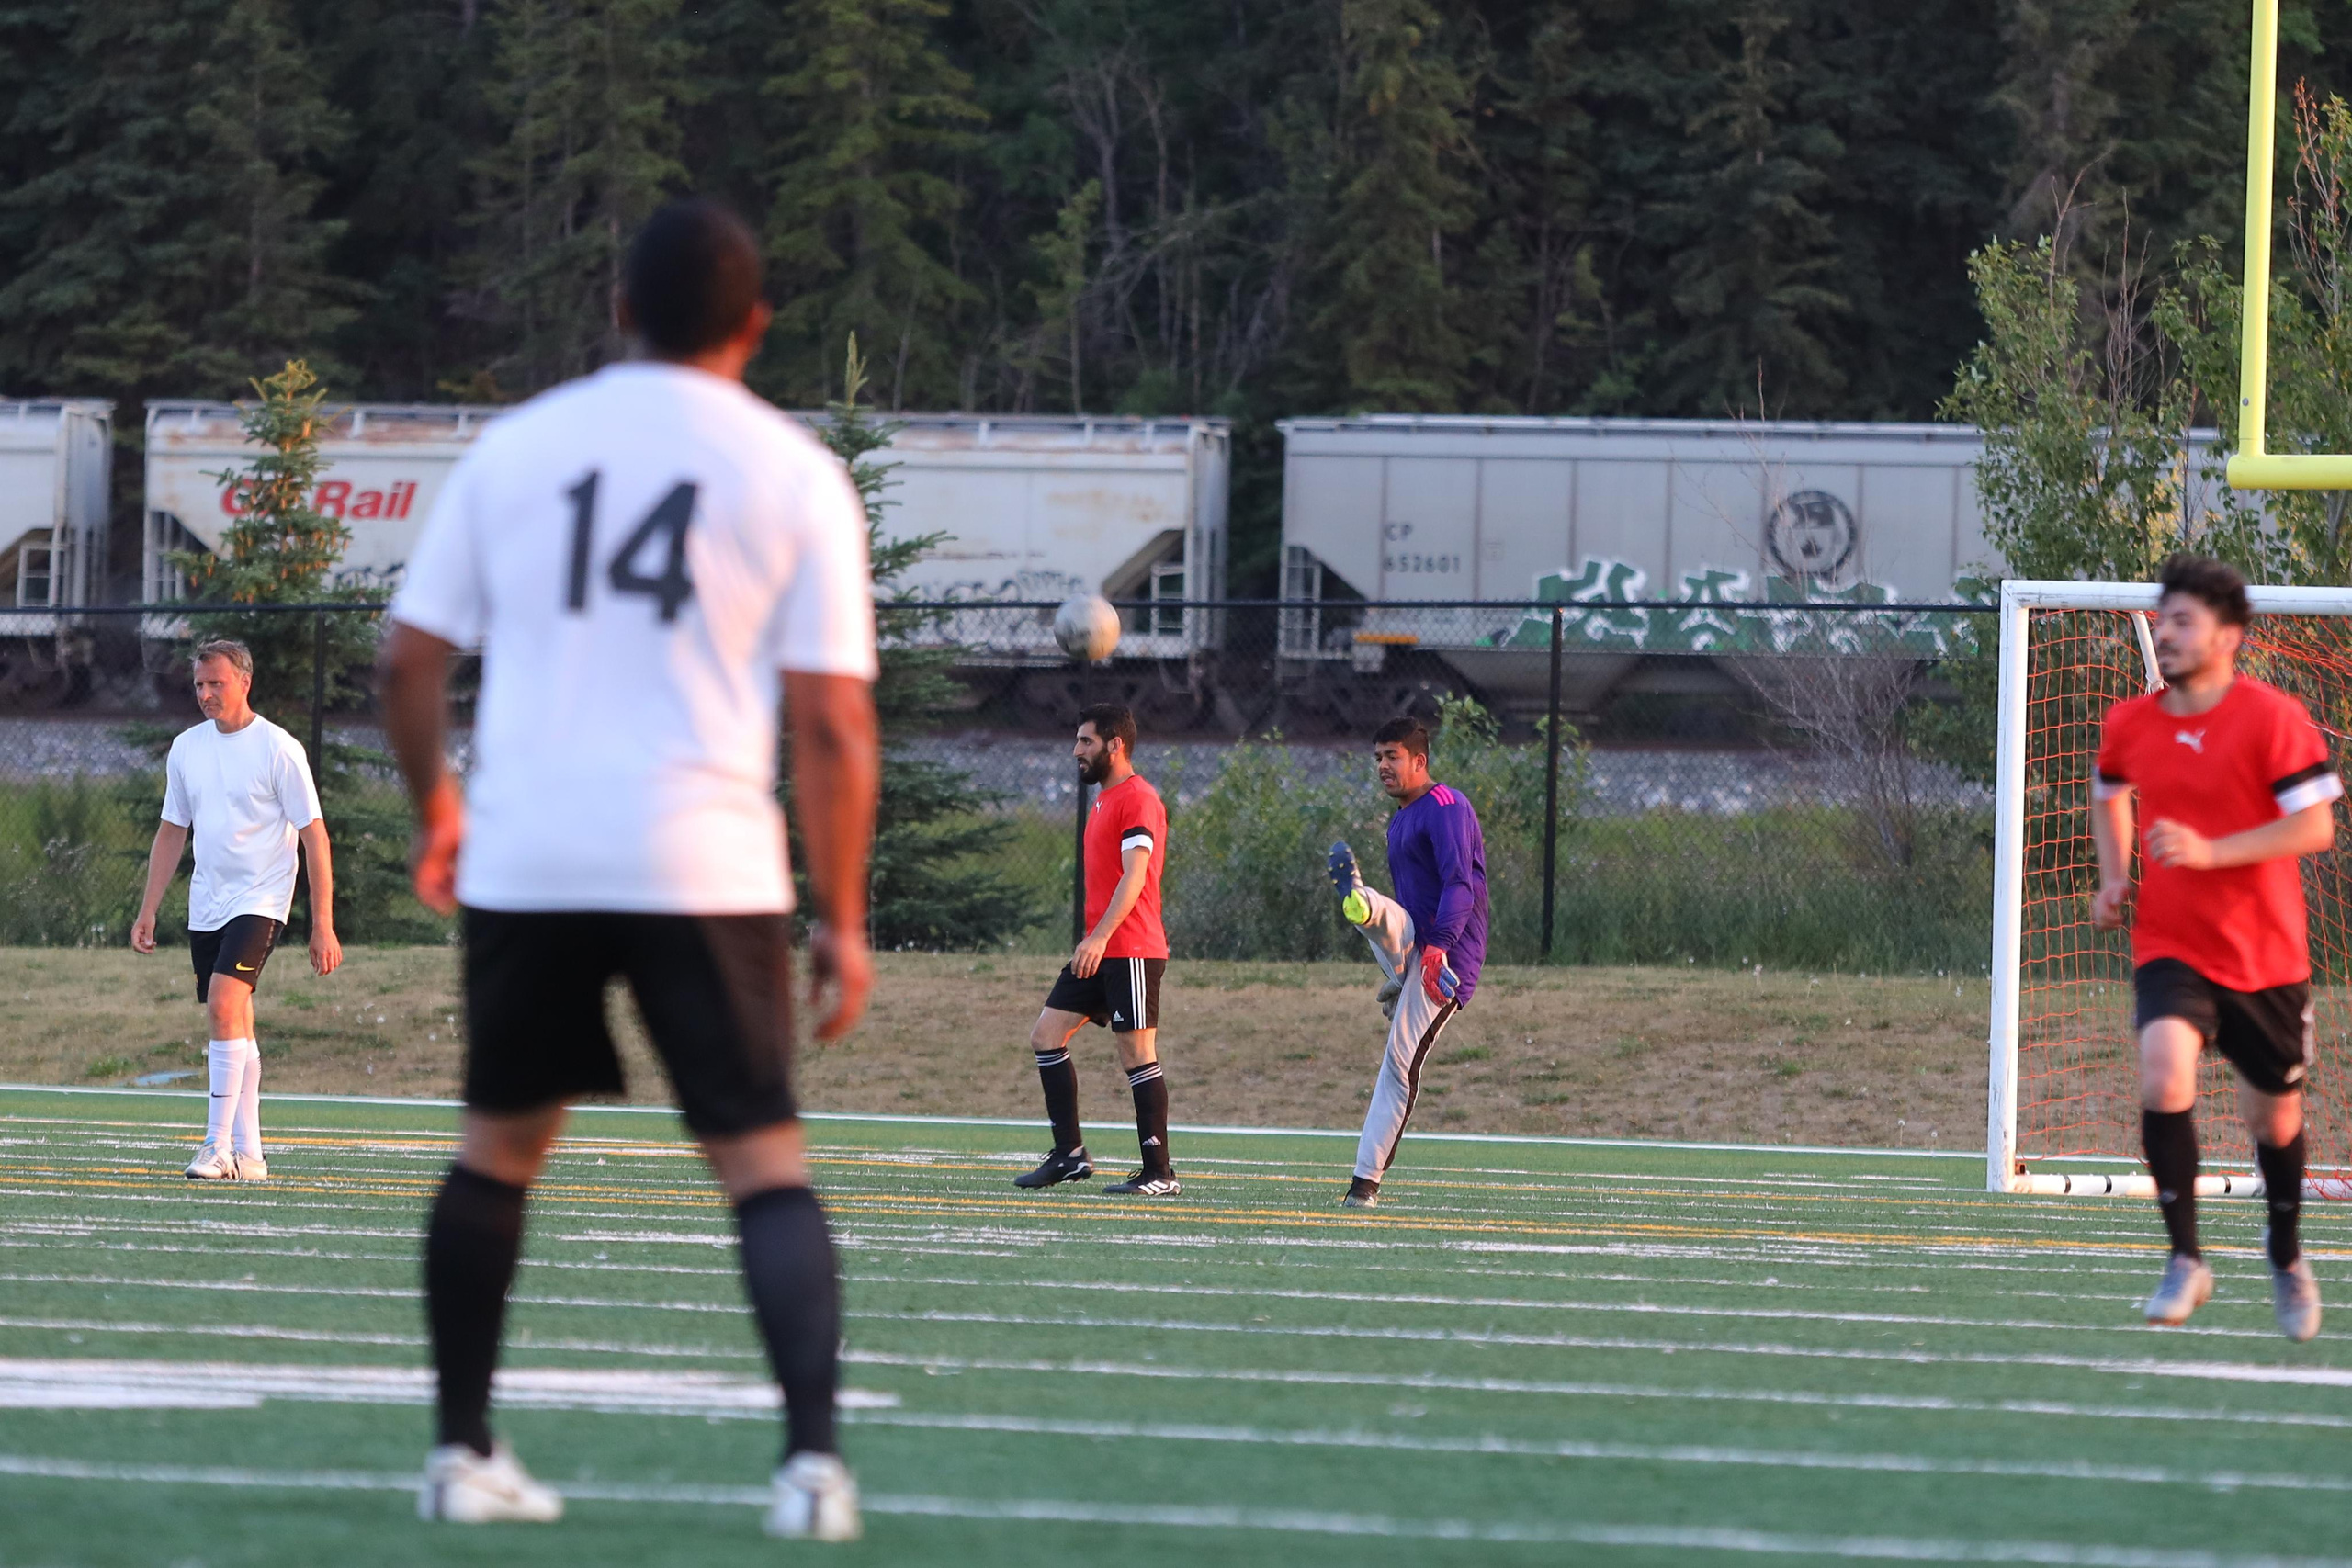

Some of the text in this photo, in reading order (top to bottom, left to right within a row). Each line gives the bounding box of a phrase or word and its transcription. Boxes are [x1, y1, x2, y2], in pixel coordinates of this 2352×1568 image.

[312, 480, 417, 520] Rail
[562, 467, 698, 625] 14
[1384, 522, 1413, 542] CP
